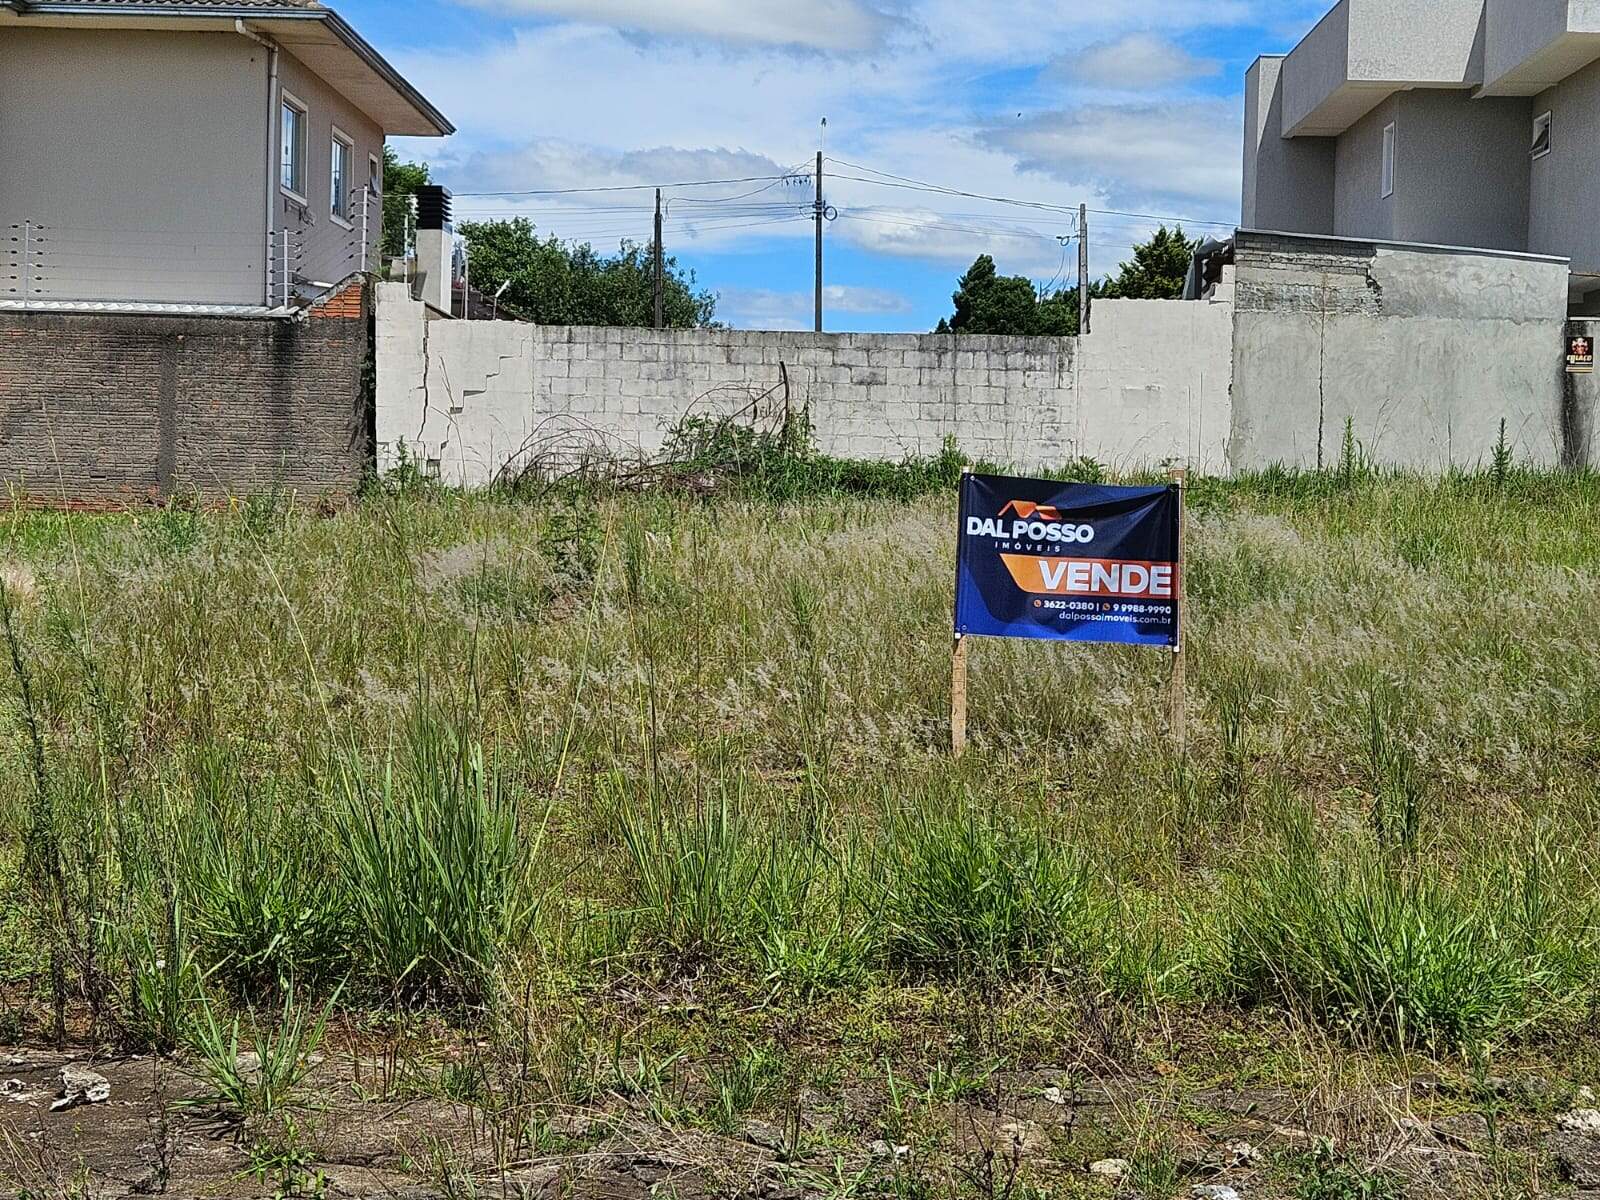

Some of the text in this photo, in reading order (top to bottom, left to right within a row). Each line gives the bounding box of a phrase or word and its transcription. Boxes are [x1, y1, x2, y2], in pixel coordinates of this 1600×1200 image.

[966, 516, 1095, 543] DAL POSSO
[995, 541, 1061, 553] IMÓVEIS
[1038, 560, 1172, 595] VENDE
[1043, 600, 1095, 610] 3622-0380
[1121, 603, 1172, 614] 9988-9990
[1058, 611, 1172, 625] dalpossoimoveis.com.br
